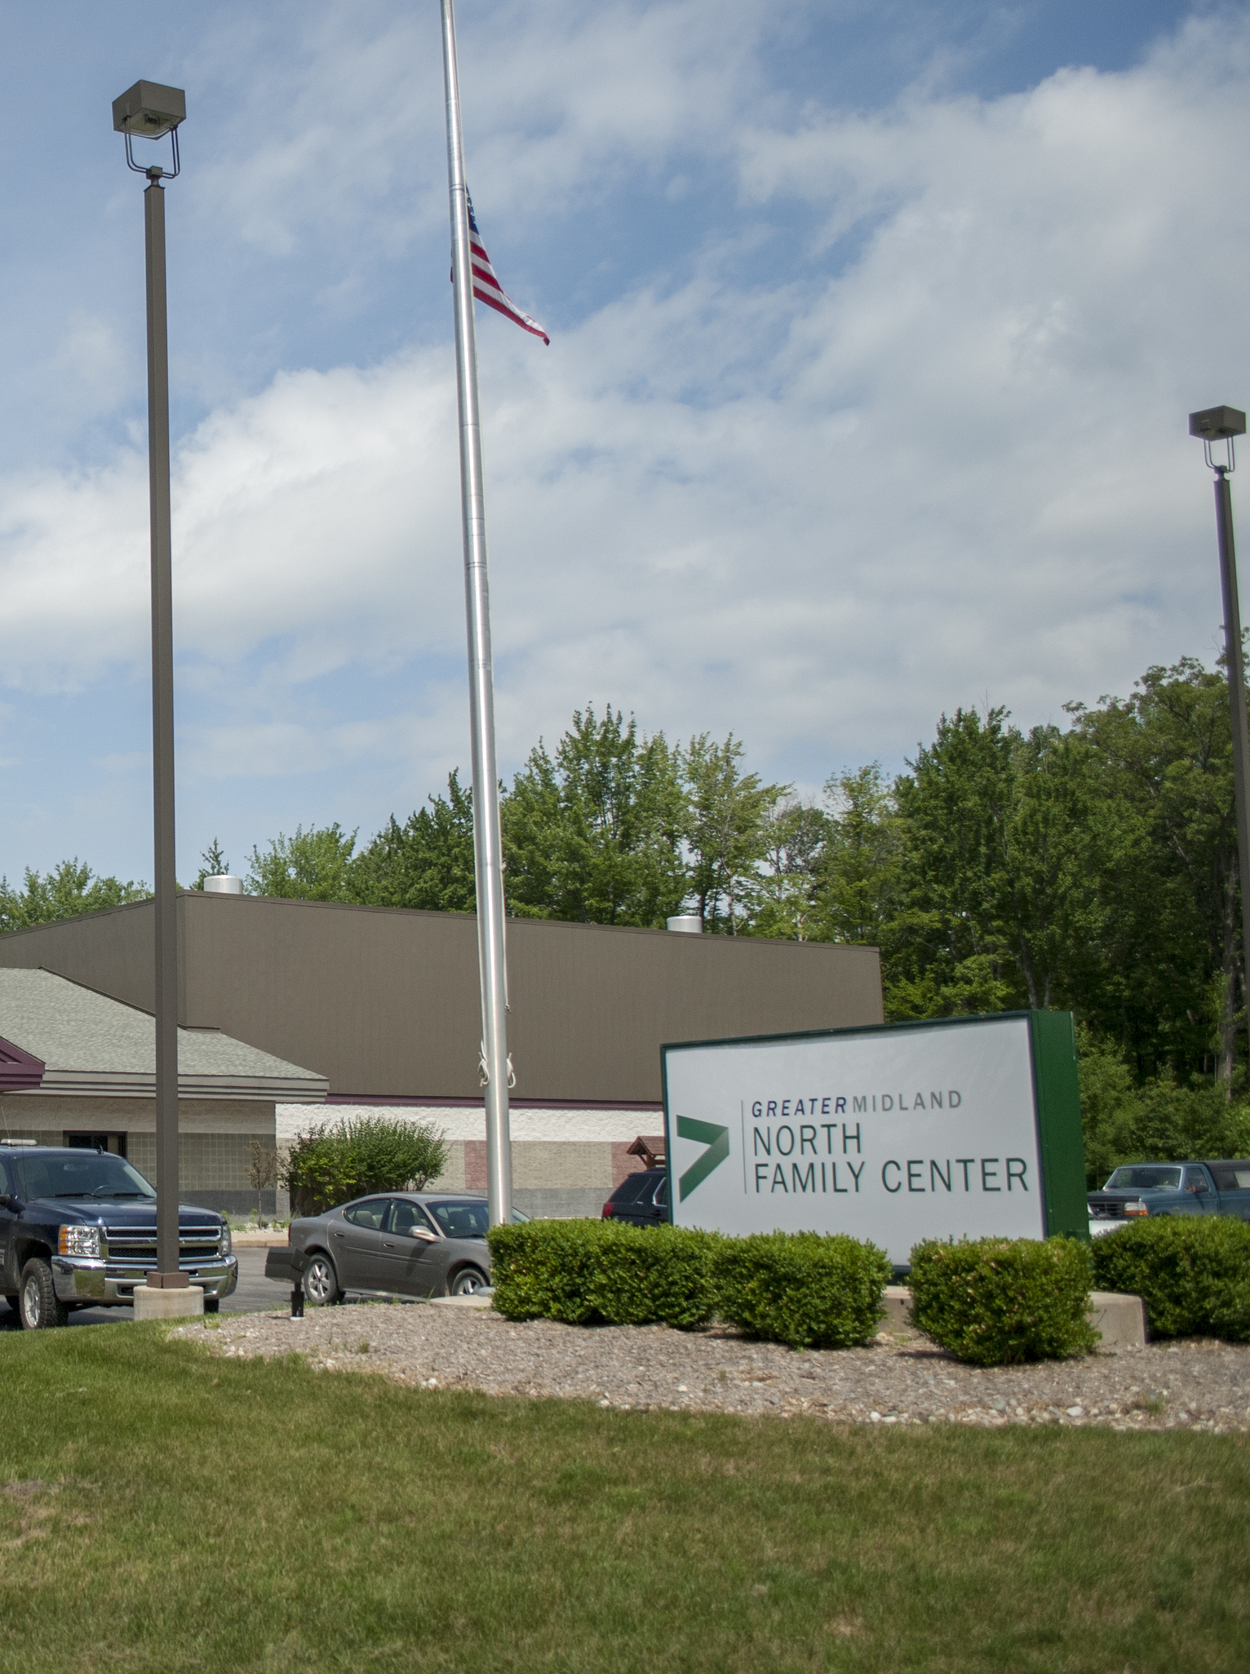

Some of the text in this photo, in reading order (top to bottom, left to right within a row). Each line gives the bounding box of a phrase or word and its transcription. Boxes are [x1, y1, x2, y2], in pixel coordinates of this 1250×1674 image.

[753, 1122, 862, 1157] NORTH
[754, 1157, 1029, 1194] FAMILY CENTER
